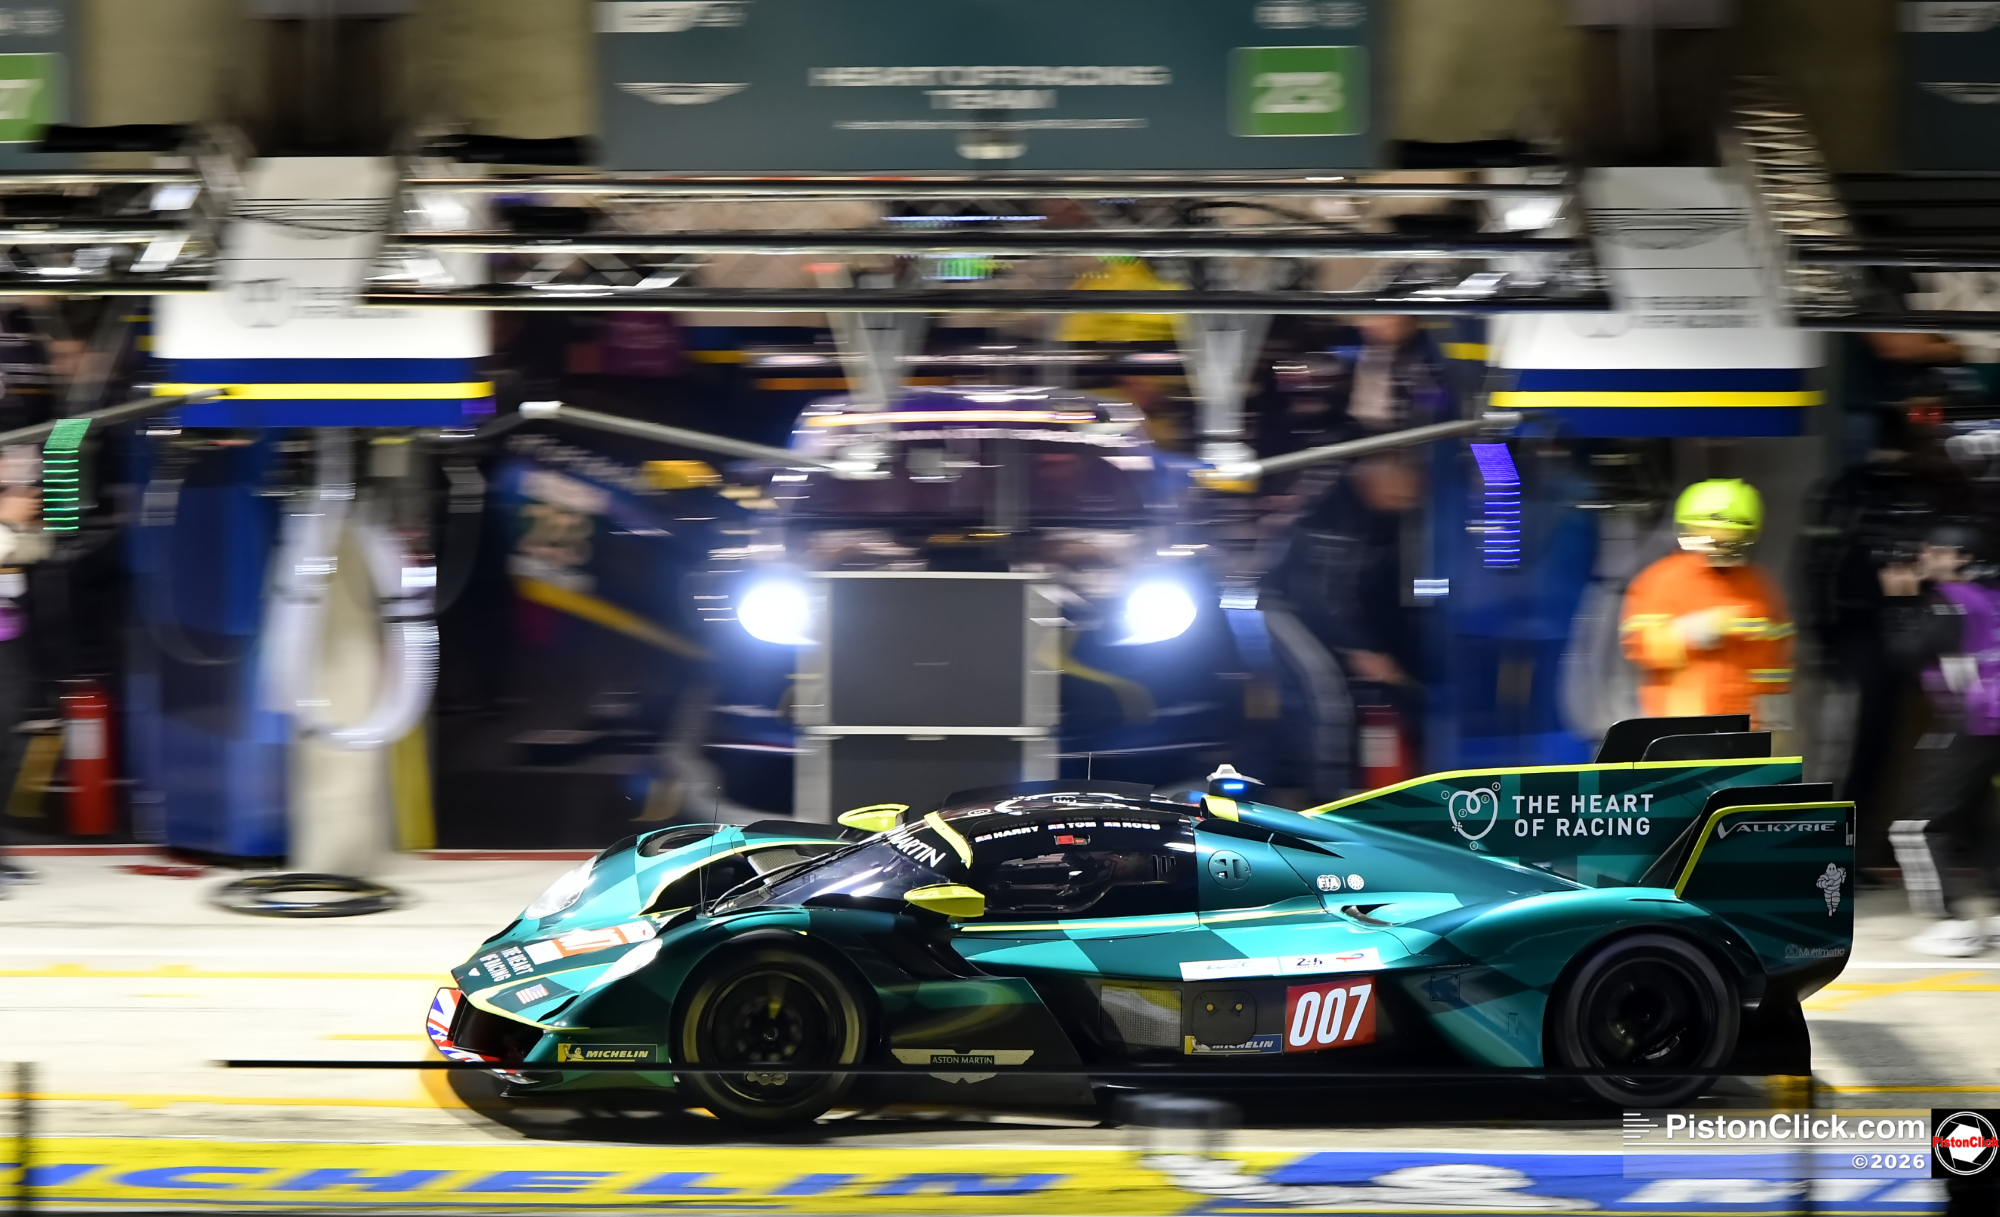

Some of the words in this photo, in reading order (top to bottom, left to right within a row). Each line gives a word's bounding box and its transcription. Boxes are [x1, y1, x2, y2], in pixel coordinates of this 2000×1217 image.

[1512, 795, 1560, 814] THE
[1571, 794, 1654, 814] HEART
[1066, 821, 1097, 829] TOM
[1122, 821, 1161, 831] ROSS
[1514, 818, 1545, 837] OF
[1556, 817, 1651, 837] RACING
[1717, 820, 1837, 840] VALKYRIE
[993, 825, 1039, 839] HARRY
[1799, 946, 1845, 957] Multimatic
[1289, 983, 1372, 1047] 007
[586, 1050, 649, 1058] MICHELIN
[932, 1056, 959, 1064] ASTON
[961, 1056, 993, 1064] MARTIN
